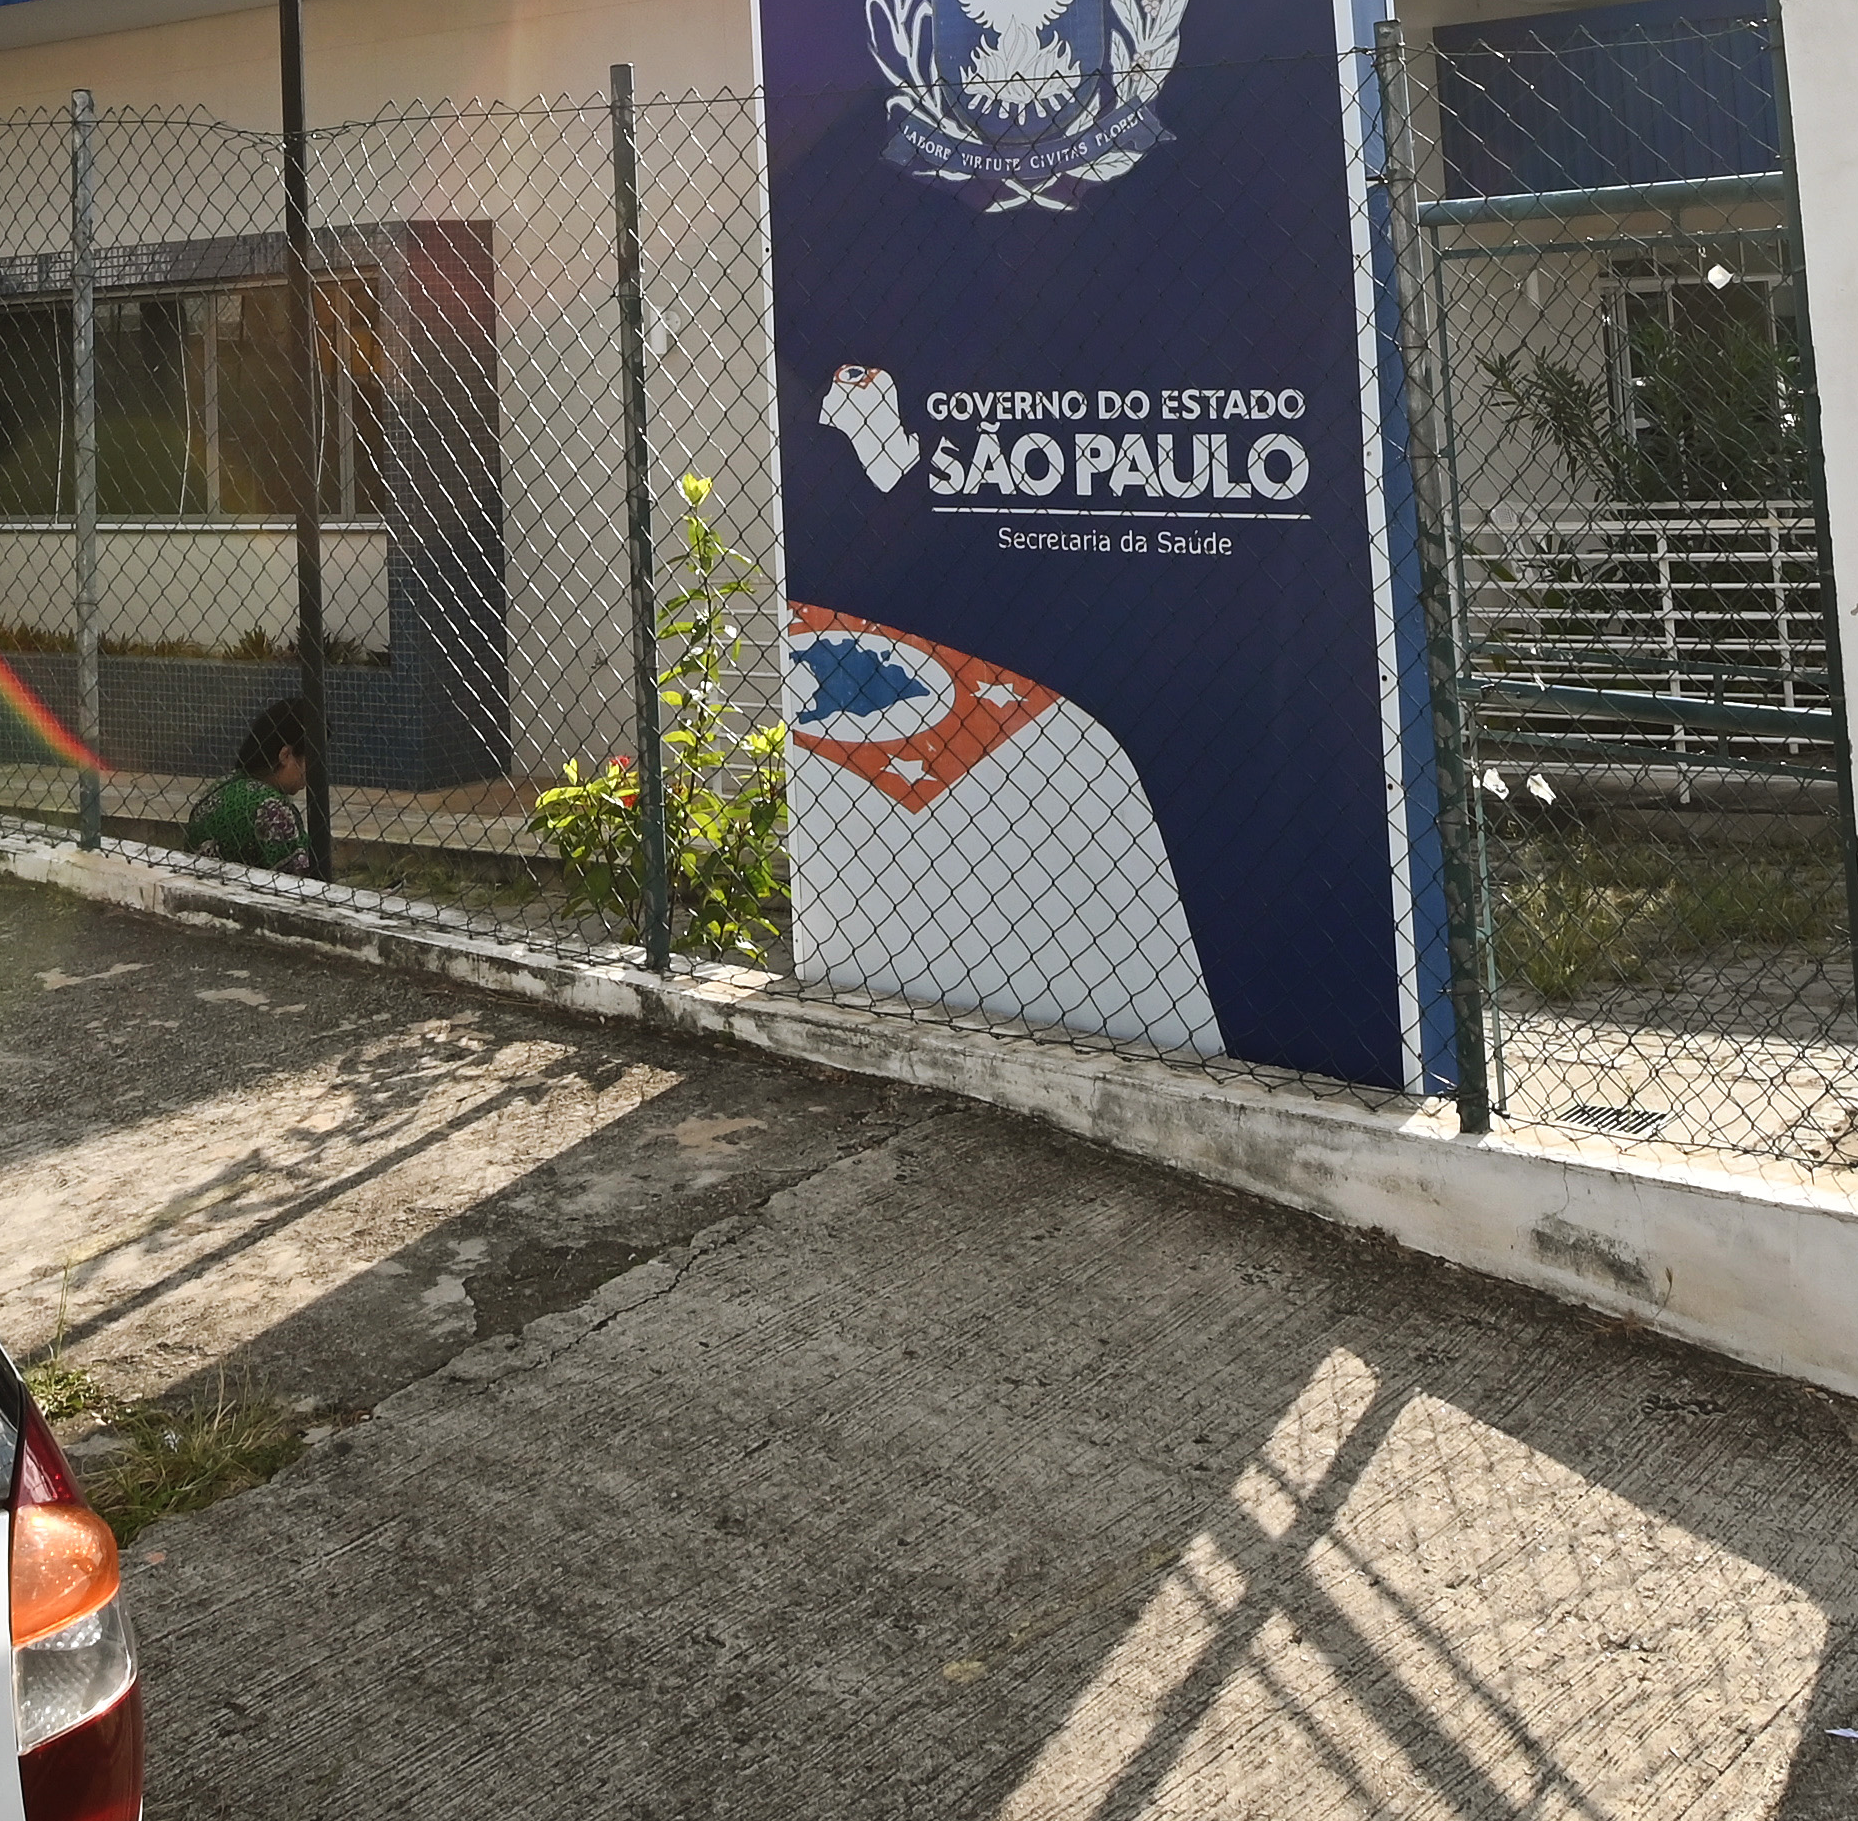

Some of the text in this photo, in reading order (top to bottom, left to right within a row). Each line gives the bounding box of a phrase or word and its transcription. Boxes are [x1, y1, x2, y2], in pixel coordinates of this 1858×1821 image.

[903, 125, 952, 161] LABORE
[961, 152, 1021, 172] VIRTUTE
[1030, 141, 1088, 169] CIVITAS
[926, 388, 1307, 421] GOVERNO DO ESTADO
[928, 420, 1311, 500] SÃO PAULO
[997, 527, 1233, 556] Secretaria da Saúde
